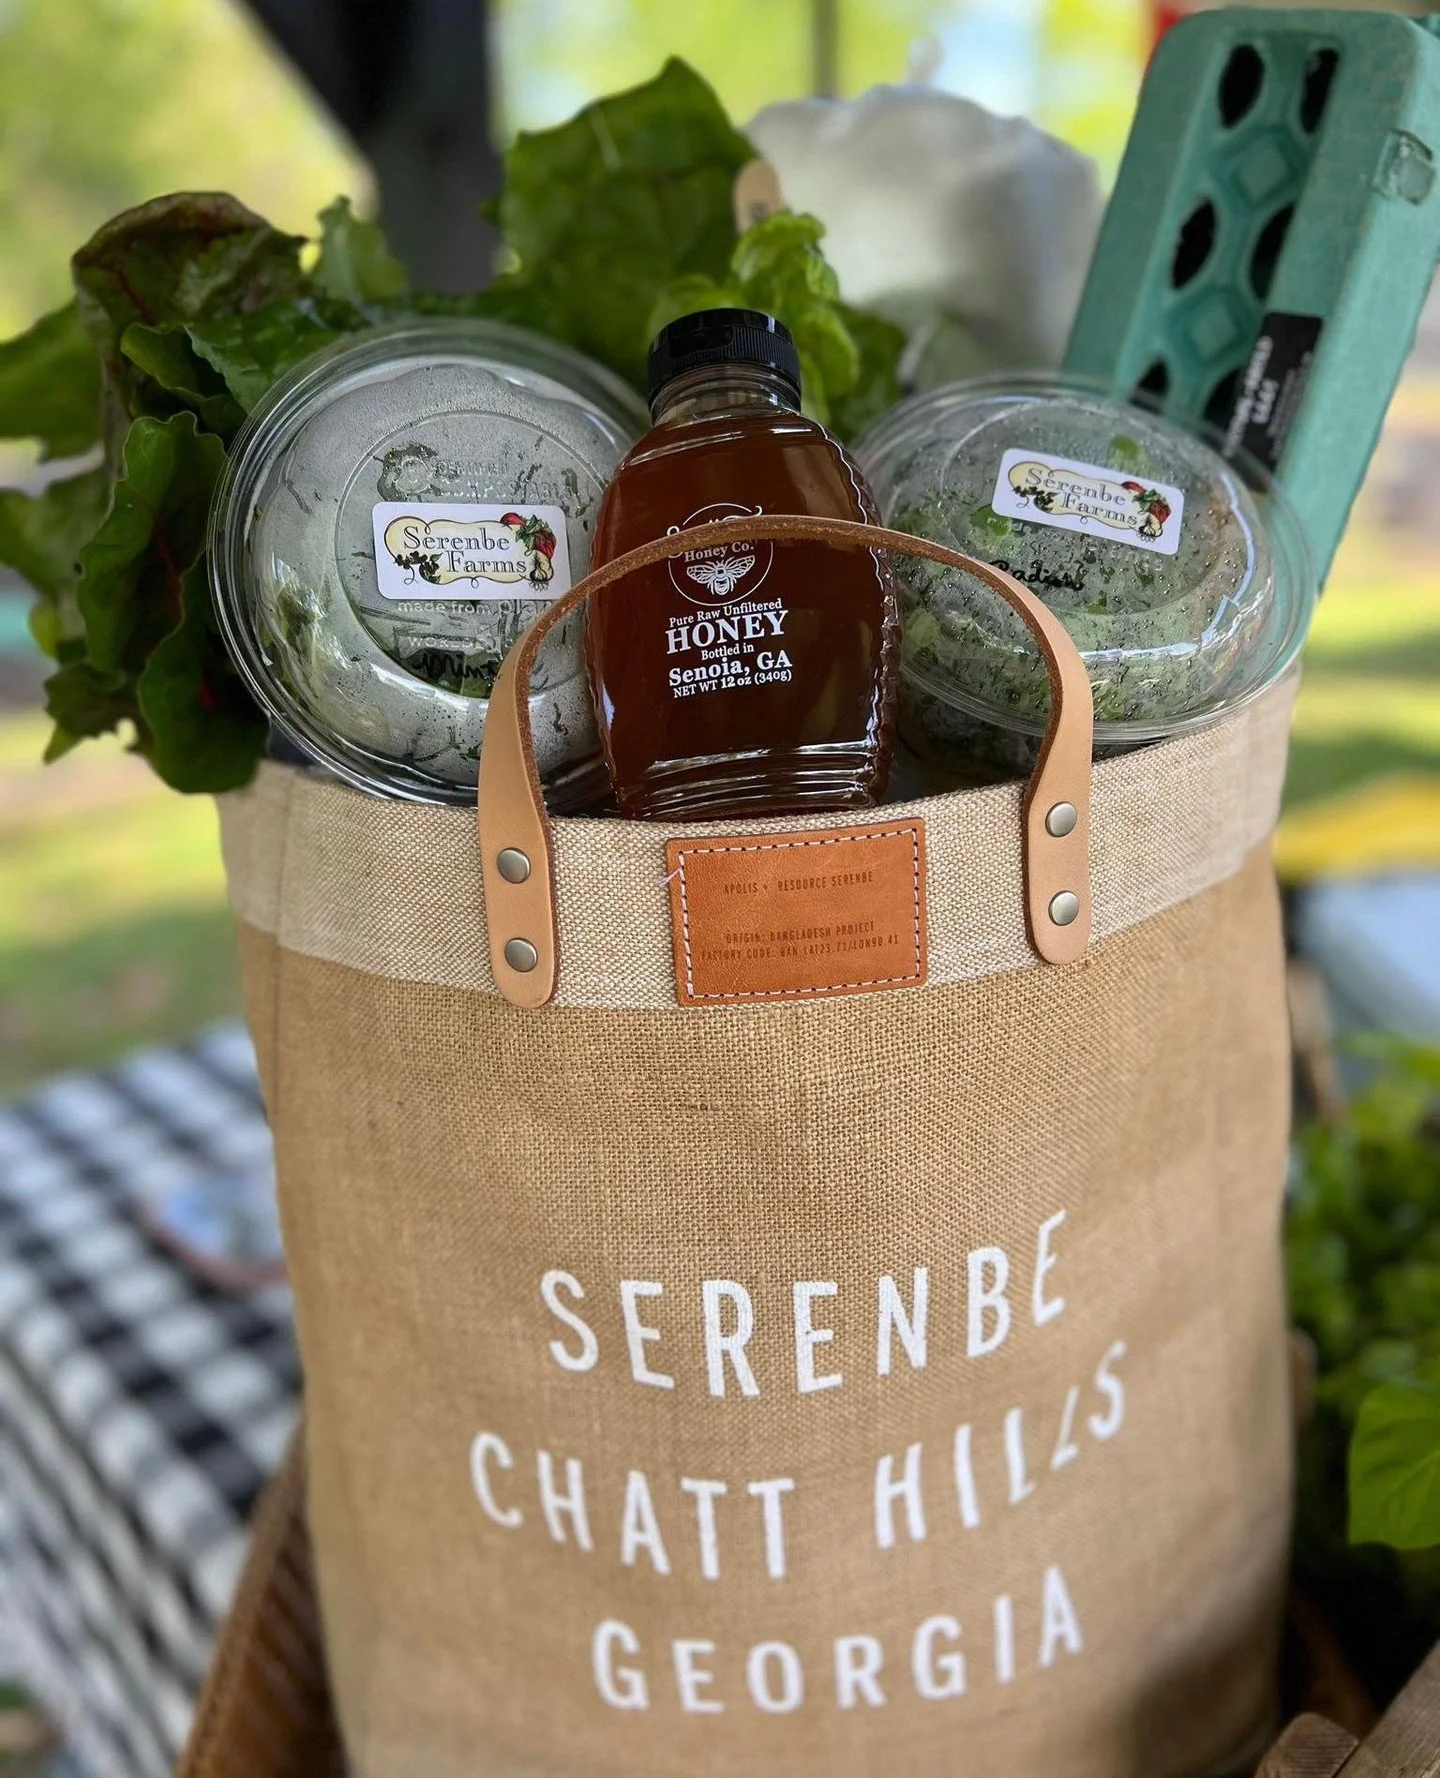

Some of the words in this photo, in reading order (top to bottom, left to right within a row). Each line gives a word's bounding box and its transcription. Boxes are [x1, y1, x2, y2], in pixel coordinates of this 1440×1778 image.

[1025, 467, 1126, 507] Serenbe
[1060, 491, 1138, 526] Farms
[403, 525, 510, 550] Serenbe
[684, 545, 728, 562] Honey
[731, 541, 754, 552] Co.
[446, 550, 527, 573] Farms
[397, 600, 446, 613] made
[450, 600, 491, 614] from
[669, 614, 694, 627] Pure
[697, 609, 721, 621] Raw
[723, 598, 783, 616] Unfiltered
[665, 610, 789, 654] HONEY
[701, 644, 740, 661] Bottled
[742, 642, 755, 653] in
[668, 657, 750, 687] Senoia,
[756, 650, 793, 670] GA
[673, 684, 697, 698] NET
[699, 680, 718, 693] WT
[720, 677, 735, 689] 12
[738, 677, 751, 686] oz
[754, 669, 792, 685] (340g)
[724, 882, 758, 895] APOLIS
[777, 876, 827, 892] RESOURCE
[831, 871, 873, 887] SERENBE
[770, 927, 831, 942] BANGLADESH
[836, 921, 875, 937] PROJECT
[540, 1209, 1066, 1398] SERENBE
[469, 1432, 795, 1581] CHATT
[872, 1340, 1126, 1550] HILLS
[592, 1565, 1082, 1714] GEORGIA
